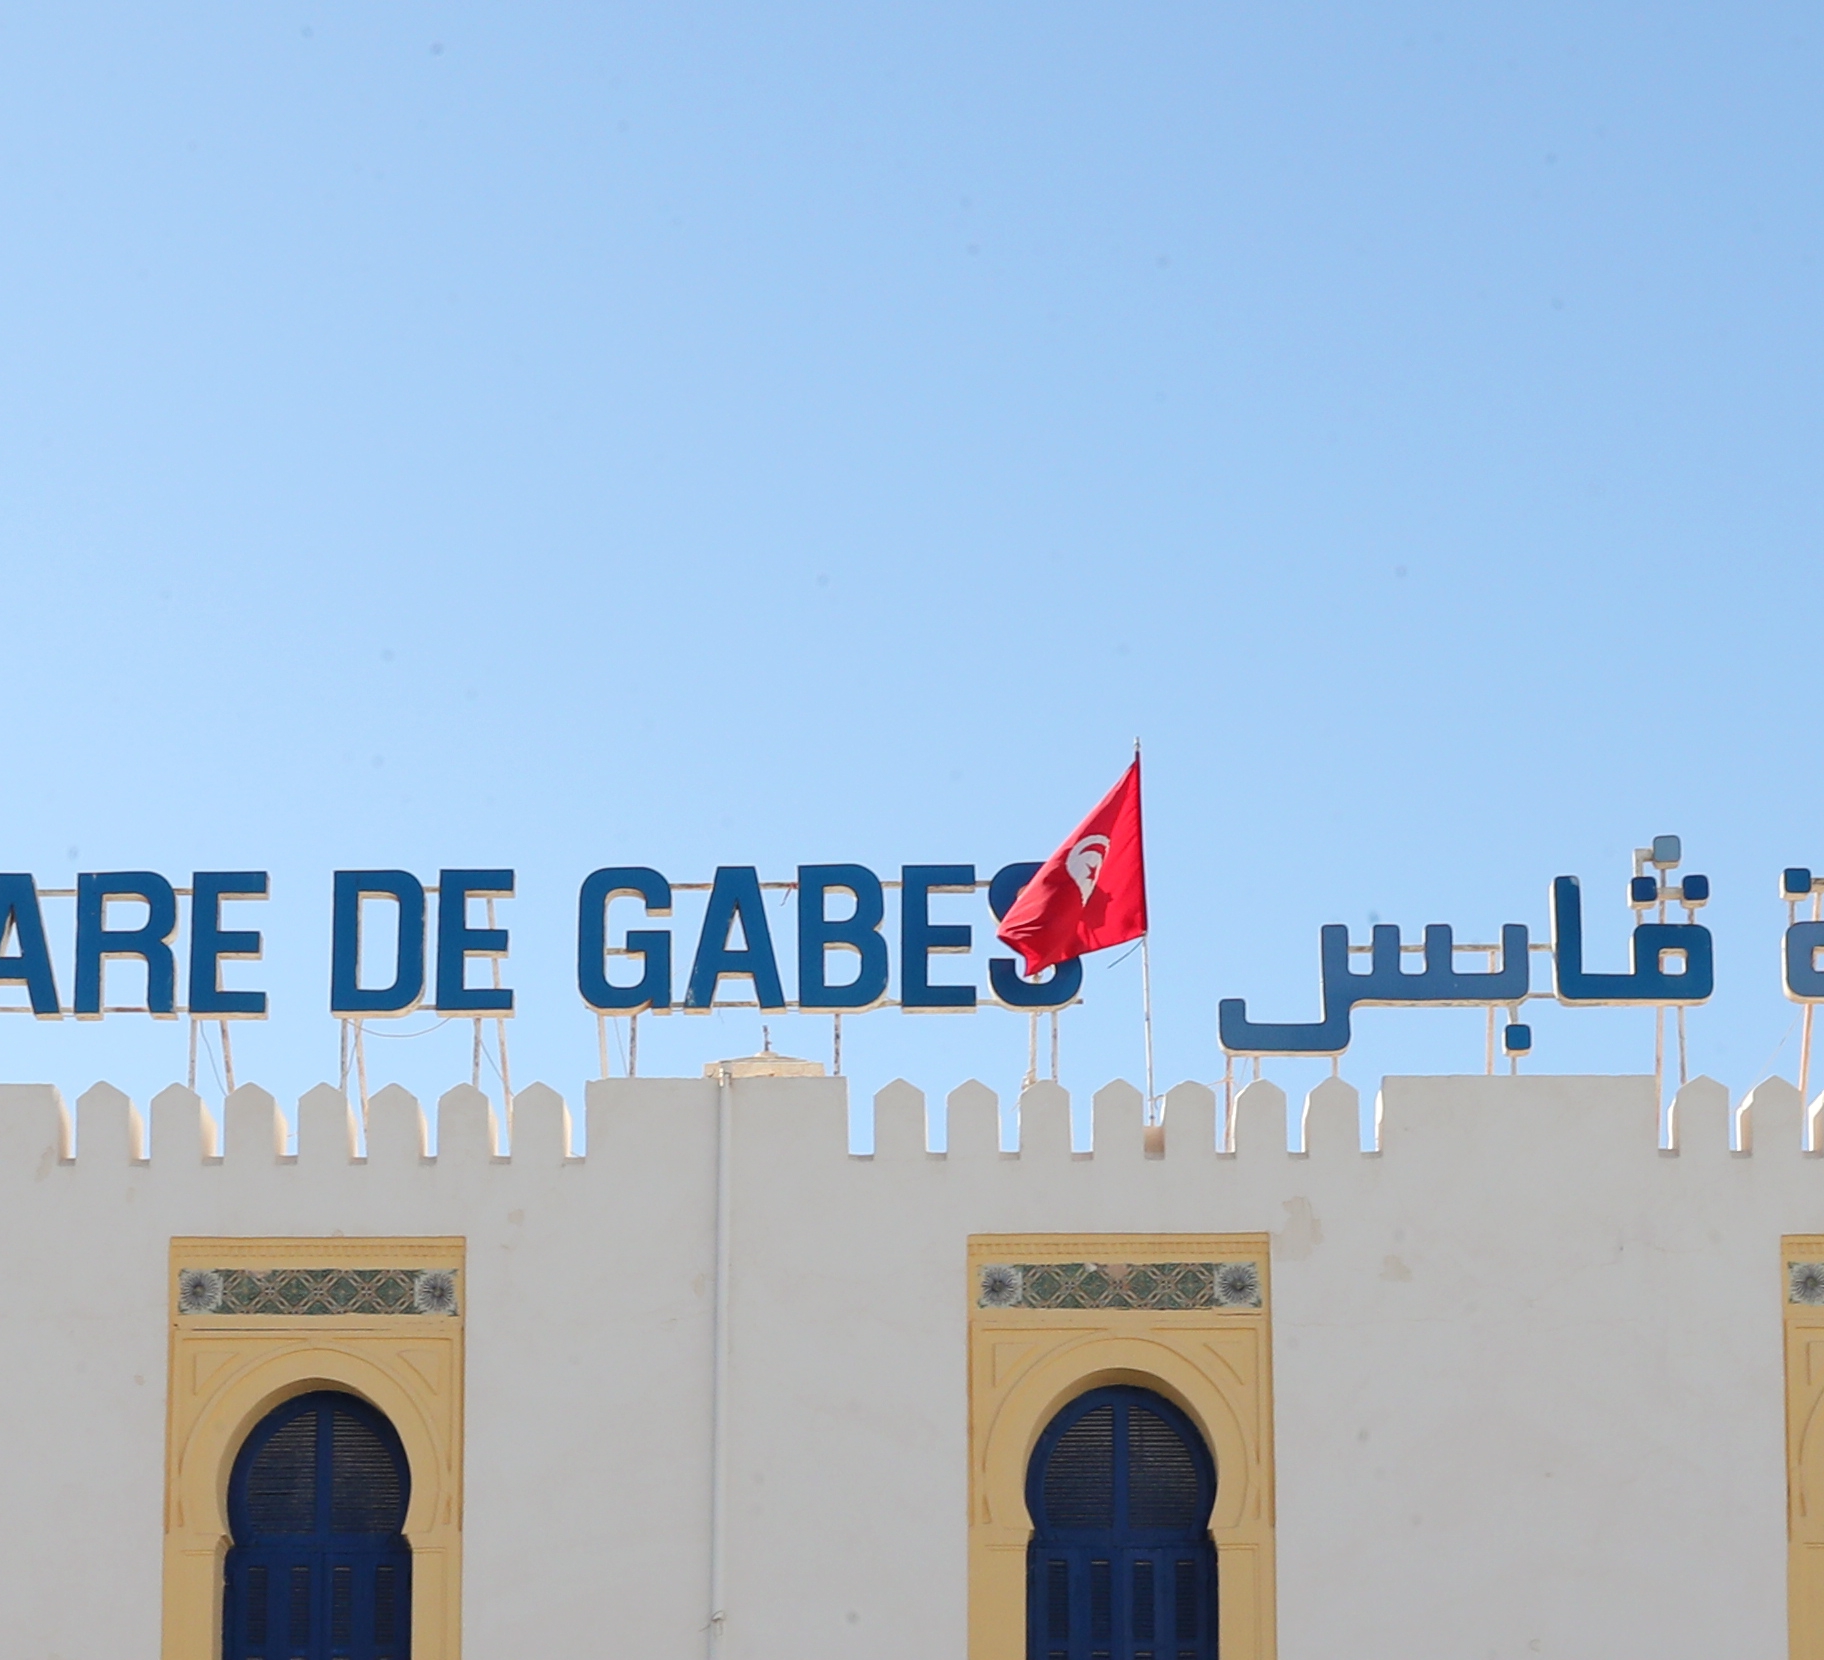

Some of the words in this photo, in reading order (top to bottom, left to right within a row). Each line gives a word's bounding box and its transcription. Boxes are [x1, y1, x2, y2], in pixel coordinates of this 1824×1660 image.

[330, 867, 516, 1019] DE
[578, 862, 1086, 1016] GABES
[1218, 834, 1714, 1056] قابس
